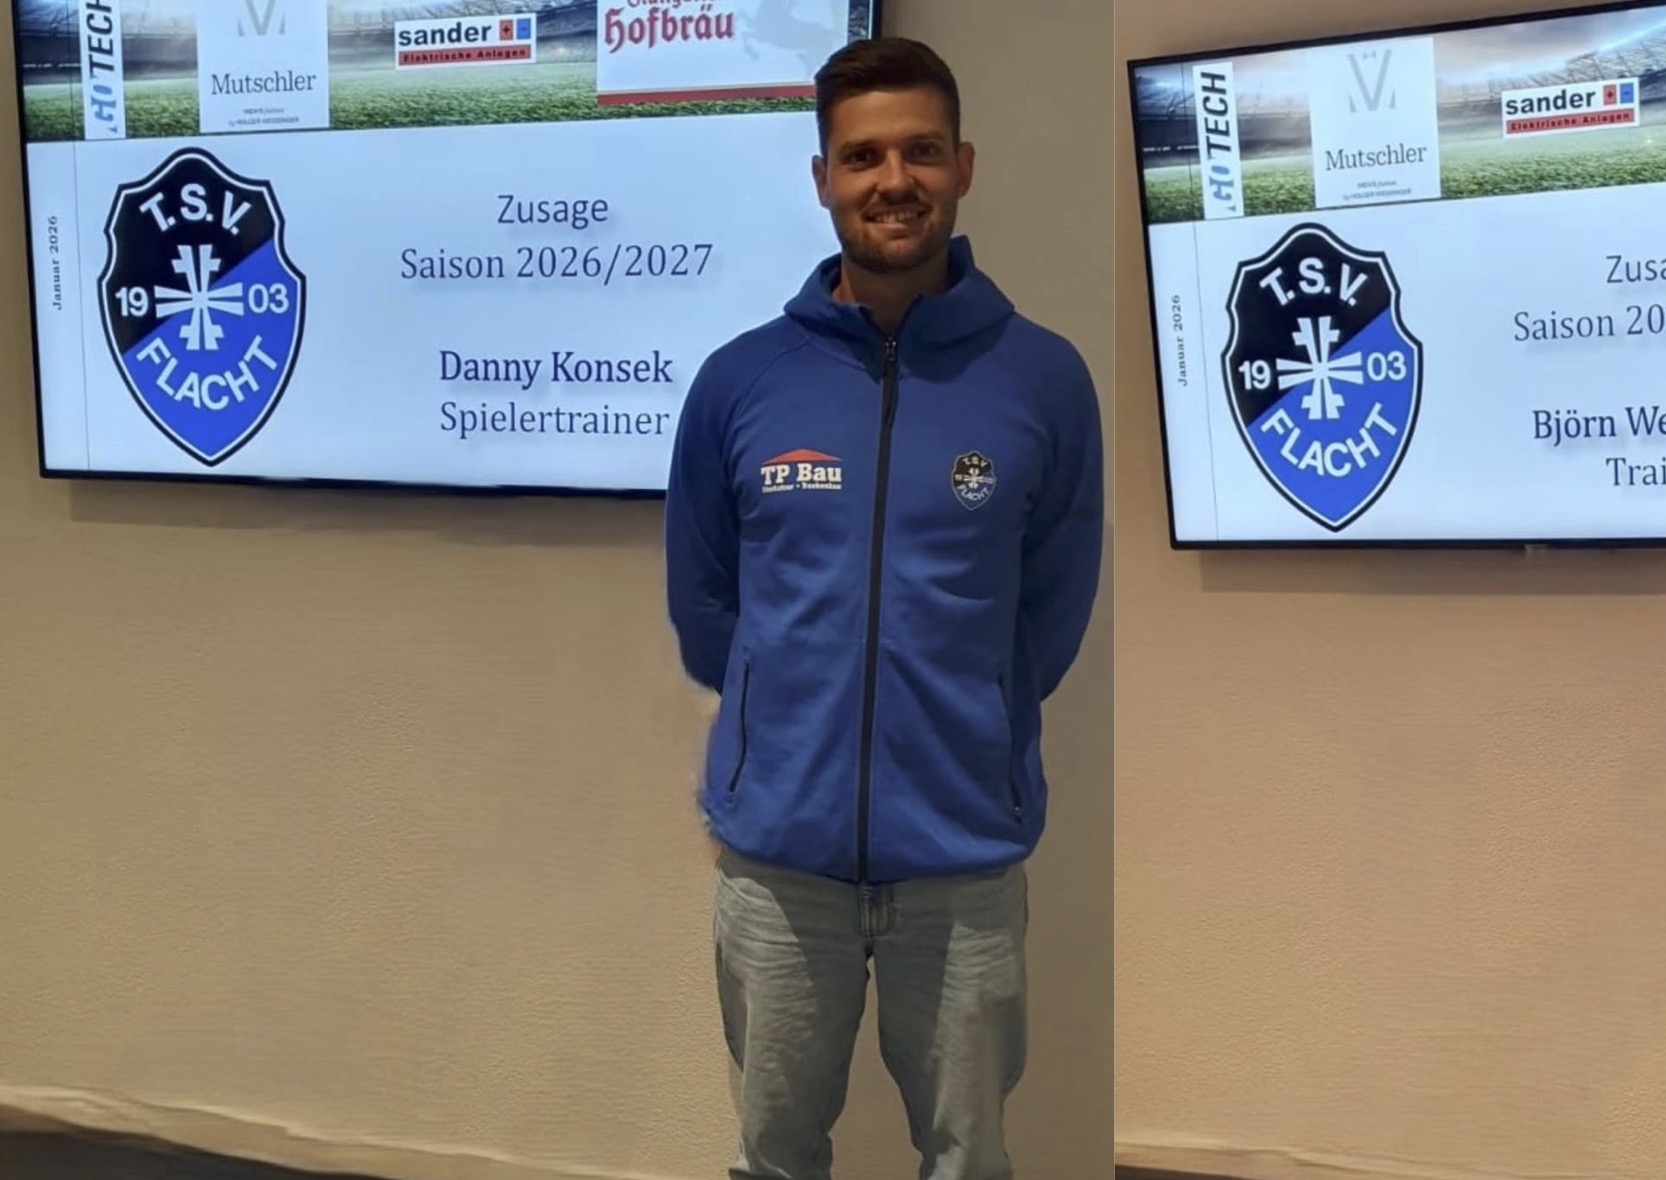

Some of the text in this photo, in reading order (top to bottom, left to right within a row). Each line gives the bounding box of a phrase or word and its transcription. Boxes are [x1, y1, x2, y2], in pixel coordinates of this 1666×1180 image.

[398, 22, 492, 47] sander
[603, 4, 734, 54] Hofbräu
[403, 49, 526, 63] Elektrische Anlagen
[211, 70, 317, 96] Mutschler
[1505, 89, 1596, 116] sander
[1510, 113, 1630, 131] Elektrische Anlagen
[1325, 143, 1427, 171] Mutschler
[139, 183, 252, 235] T.S.V.
[497, 194, 609, 230] Zusage
[48, 215, 62, 310] Januar 2026
[400, 244, 714, 286] Saison 2026/2027
[248, 283, 290, 313] 03
[1259, 257, 1368, 306] T.S.V.
[115, 286, 148, 317] 19
[1171, 295, 1188, 387] Januar 2026
[1513, 311, 1616, 341] Saison
[136, 334, 278, 410] FLACHT
[439, 350, 674, 391] Danny Konsek
[1238, 360, 1271, 390] 19
[1367, 351, 1407, 382] 03
[440, 401, 671, 439] Spielertrainer
[1532, 409, 1617, 447] Björn
[1260, 402, 1398, 477] FLACHT
[761, 463, 842, 485] TP Bau
